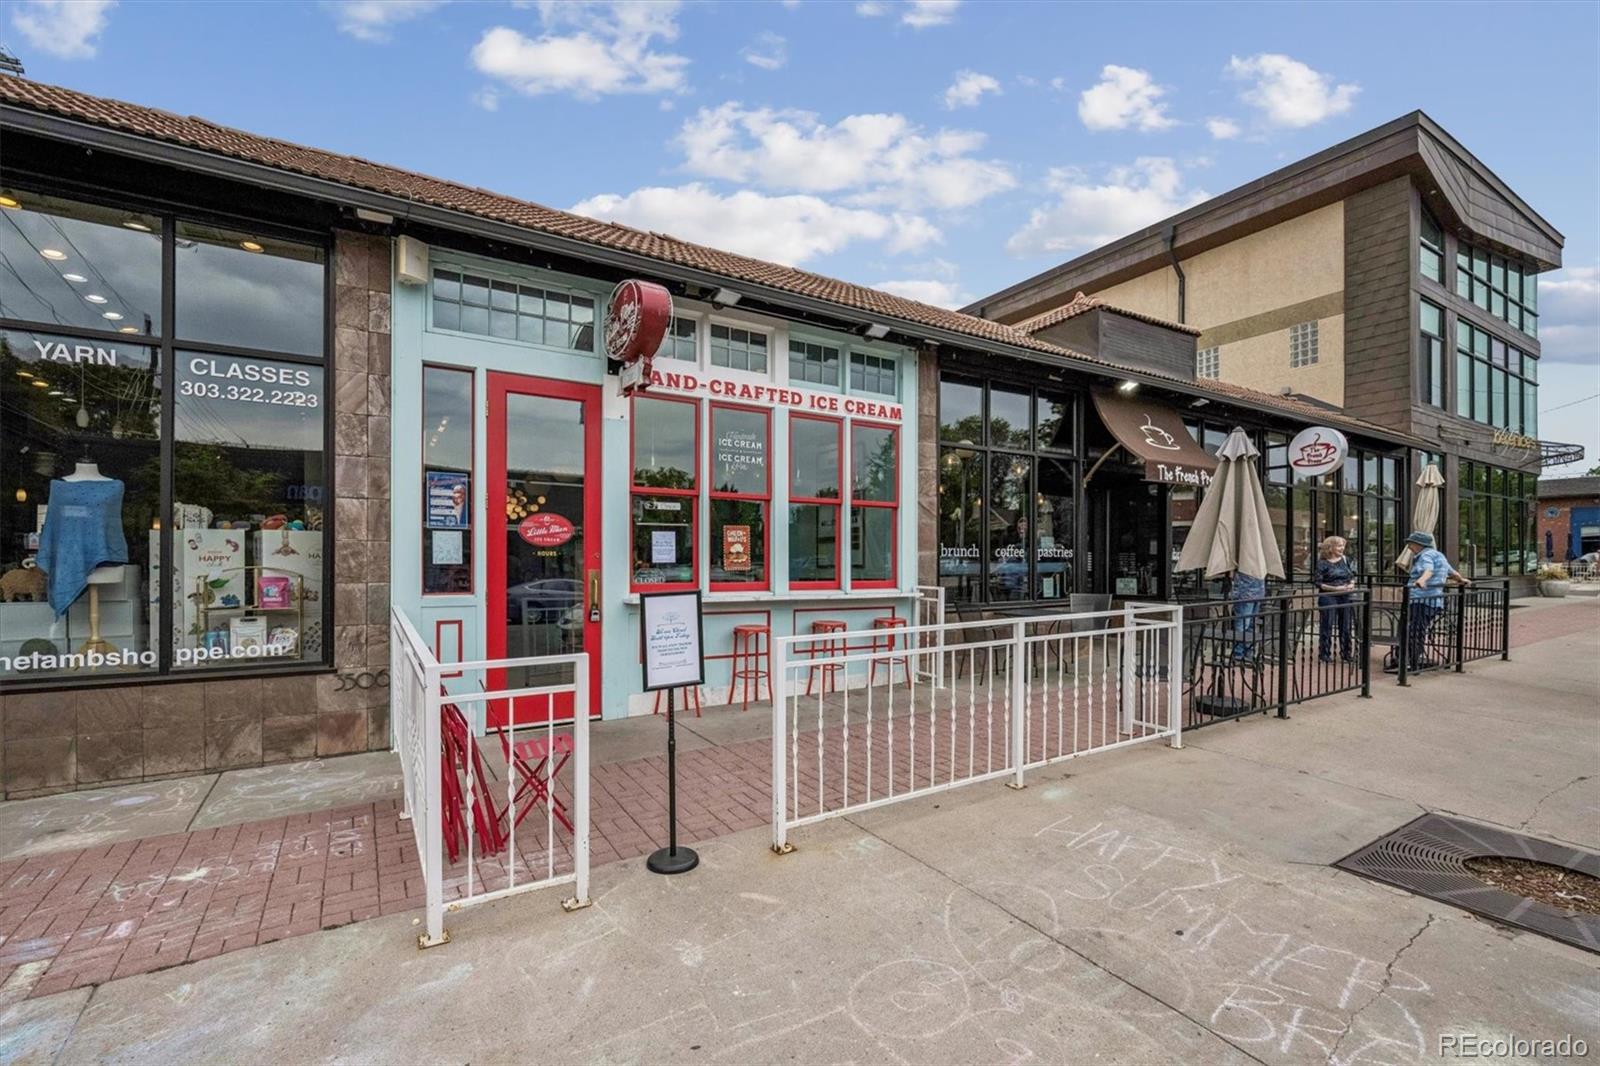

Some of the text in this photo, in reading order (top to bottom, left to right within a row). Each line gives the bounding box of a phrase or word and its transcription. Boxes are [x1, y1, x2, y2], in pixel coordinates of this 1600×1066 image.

[32, 341, 117, 367] YARN
[189, 358, 311, 387] CLASSES
[180, 380, 319, 408] 303.322.2223
[651, 369, 902, 420] AND-CRAFTED ICE CREAM
[718, 438, 762, 449] ICE CREAM
[718, 453, 763, 465] ICE CREAM
[1157, 464, 1174, 481] The
[1175, 465, 1200, 484] French
[940, 542, 1074, 560] brunch coffee pastries
[1034, 814, 1244, 893] HAPPY
